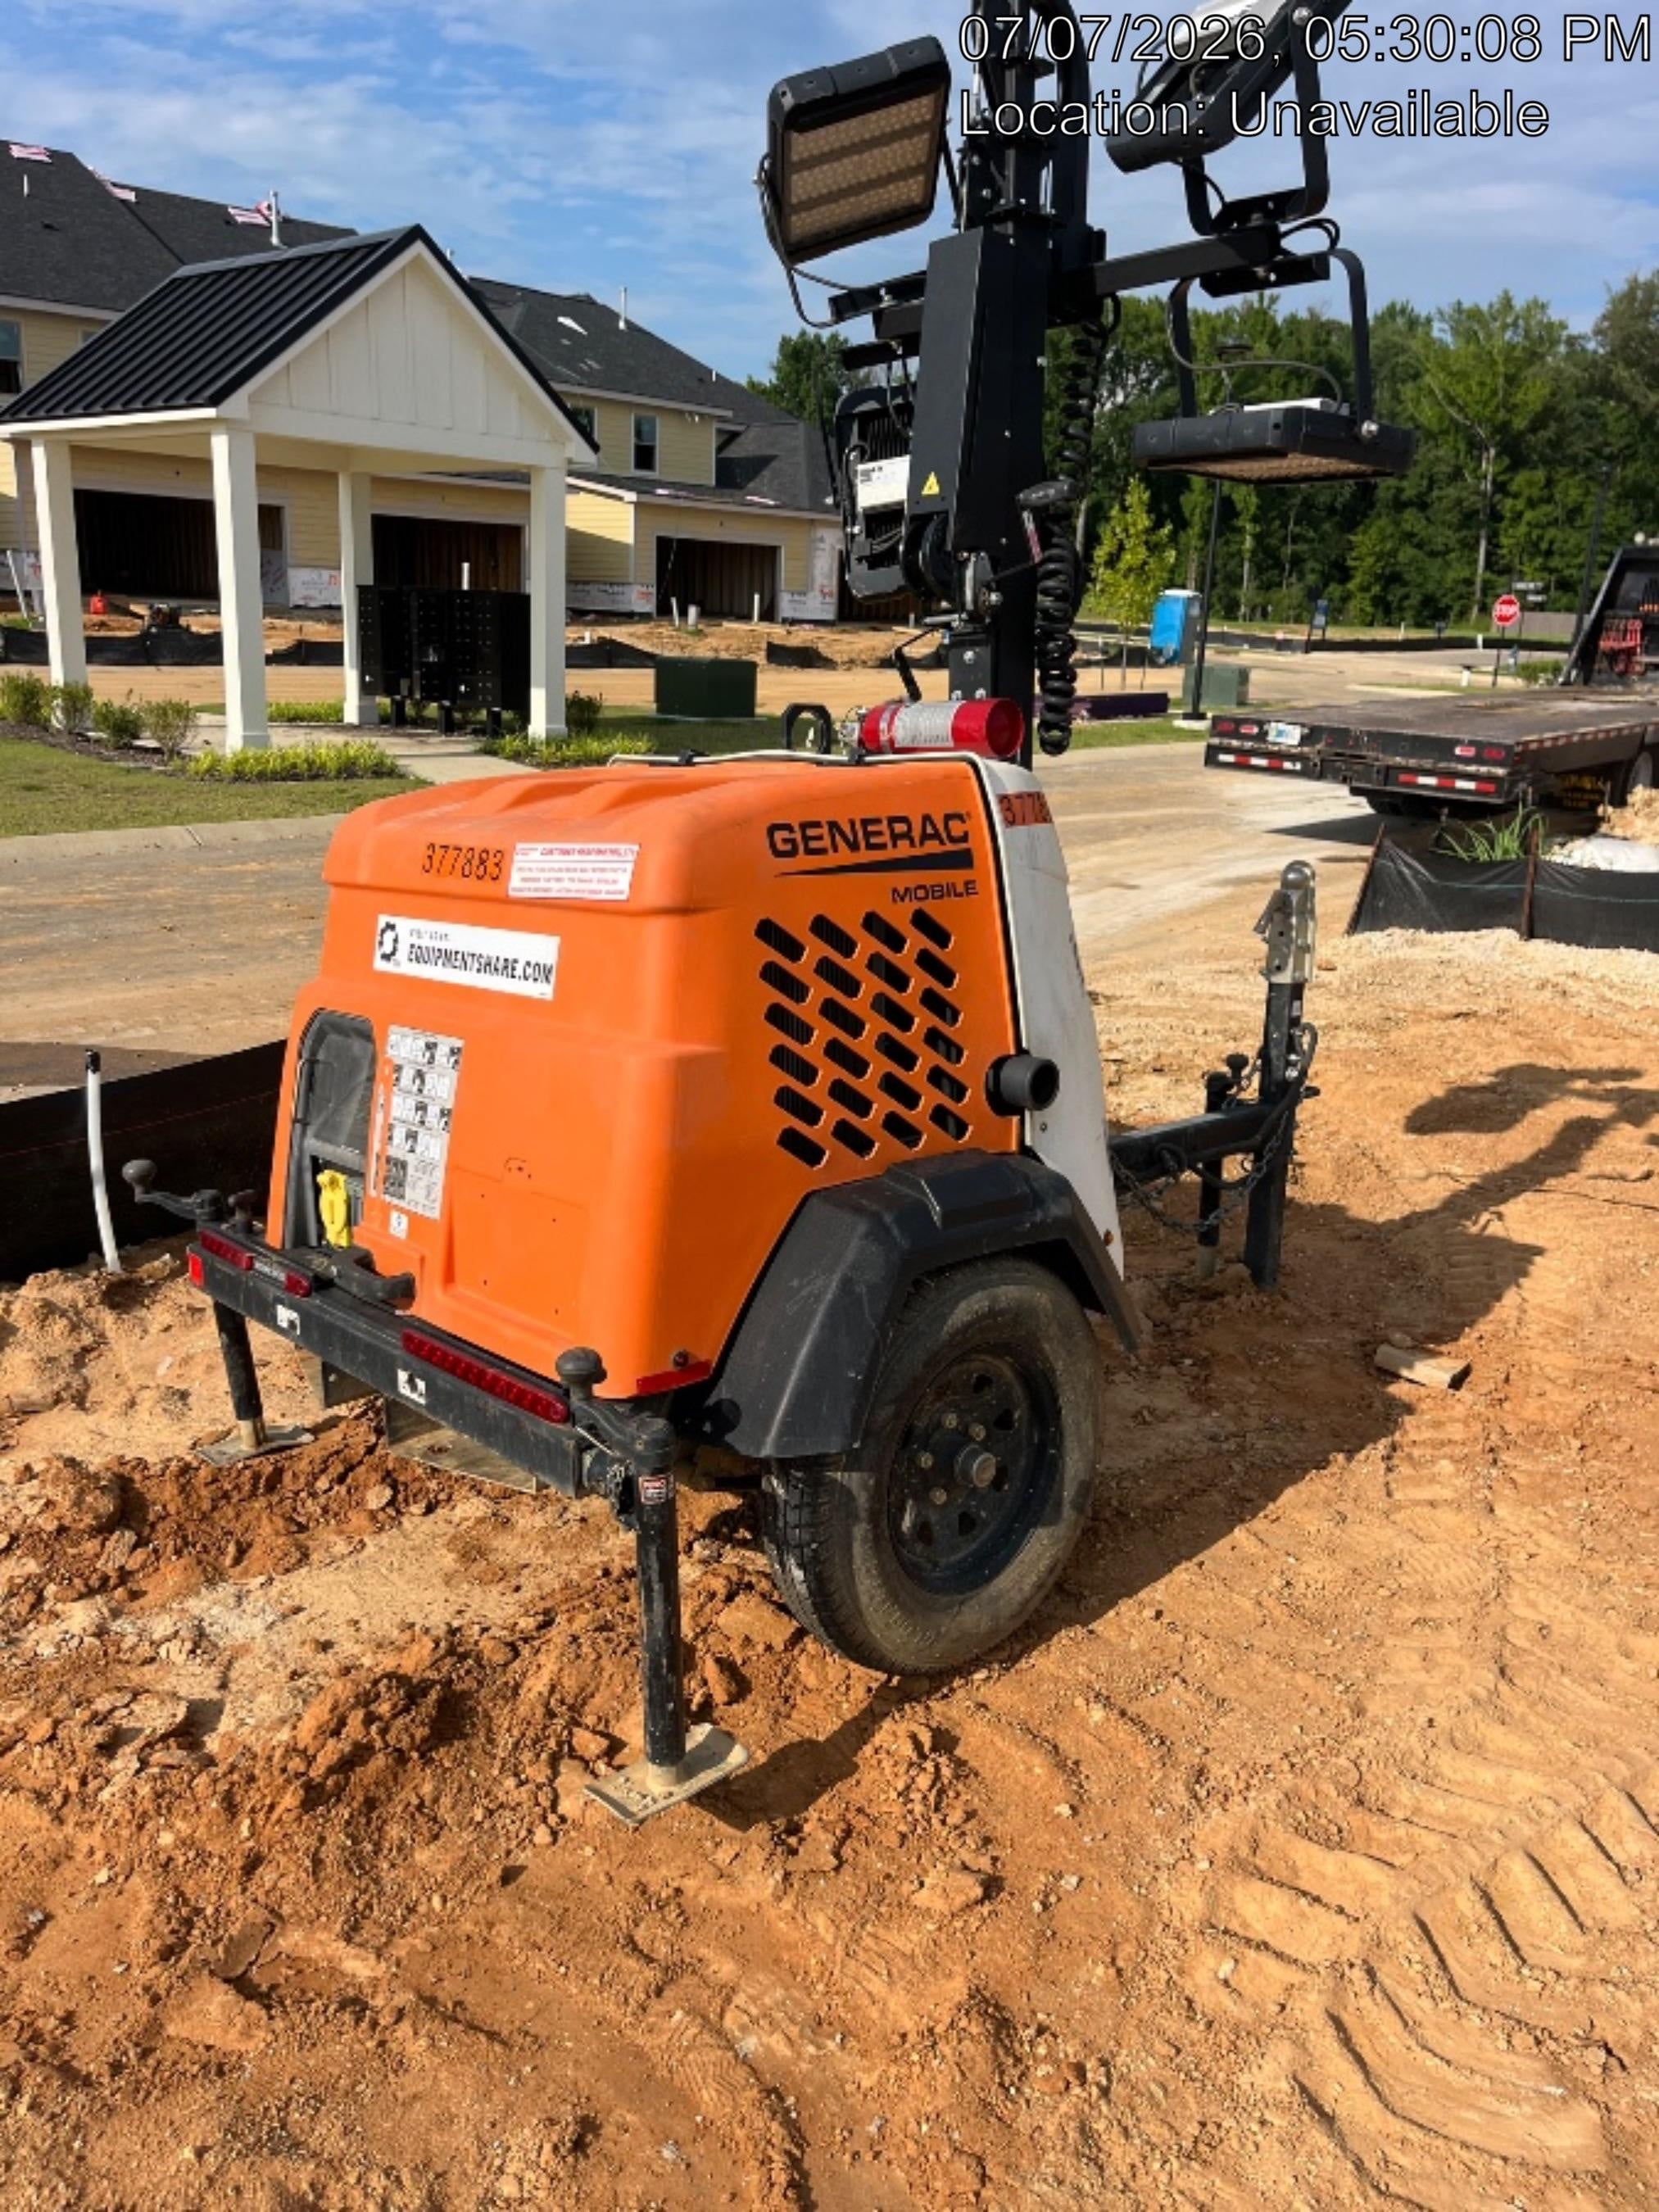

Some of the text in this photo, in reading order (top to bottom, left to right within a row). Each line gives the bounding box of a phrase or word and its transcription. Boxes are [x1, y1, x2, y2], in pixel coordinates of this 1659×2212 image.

[766, 812, 970, 859] GENERAC
[422, 842, 505, 881] 377883
[891, 880, 978, 904] MOBILE
[407, 942, 555, 985] EQUIPMENTSHARE.COM
